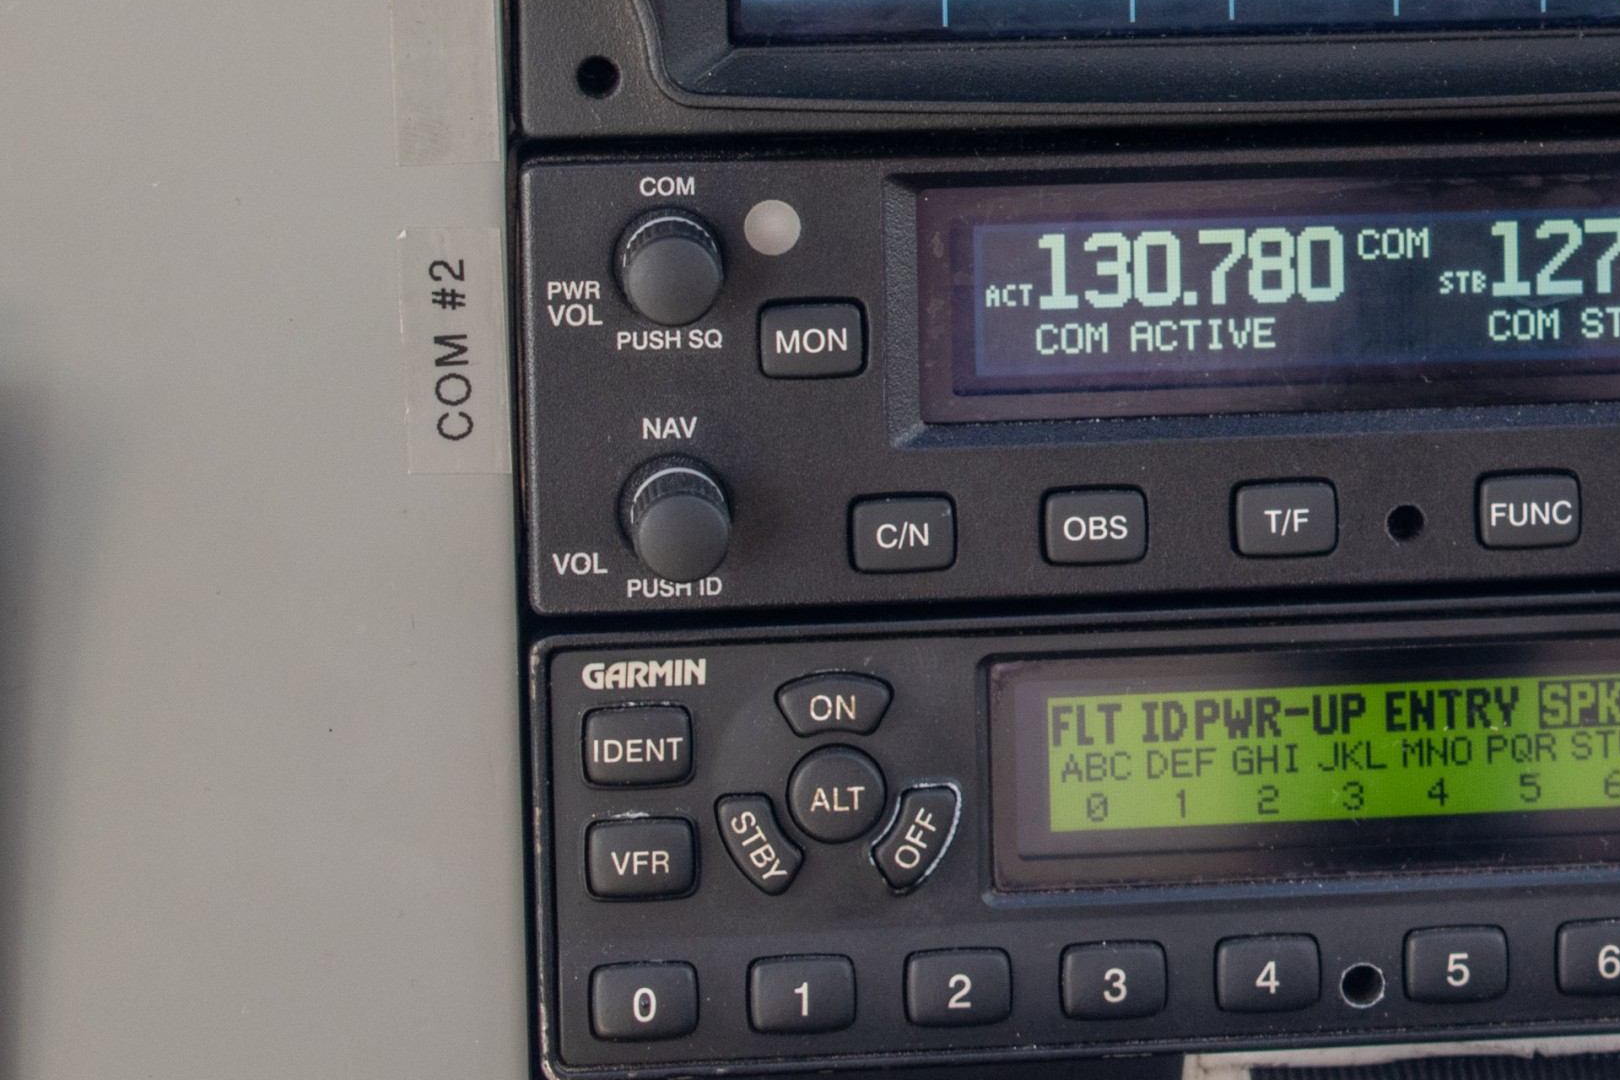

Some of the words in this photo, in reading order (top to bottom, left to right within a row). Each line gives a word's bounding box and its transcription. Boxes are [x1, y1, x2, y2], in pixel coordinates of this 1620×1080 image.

[639, 178, 695, 197] COM
[986, 284, 1034, 308] ACT
[1037, 227, 1344, 310] 130.780
[1357, 227, 1429, 260] COM
[1440, 271, 1487, 294] STB
[429, 258, 466, 310] #2
[547, 281, 601, 301] PWR
[548, 304, 602, 328] VOL
[616, 331, 678, 352] PUSH
[681, 329, 723, 350] SQ
[775, 330, 848, 354] MON
[1036, 324, 1109, 355] COM
[1130, 318, 1277, 352] ACTIVE
[1488, 308, 1561, 342] COM
[434, 334, 474, 441] COM
[642, 418, 698, 439] NAV
[1264, 509, 1309, 534] T/F
[1490, 502, 1572, 527] FUNC
[876, 523, 930, 549] C/N
[1062, 516, 1128, 542] OBS
[552, 554, 608, 576] VOL
[582, 659, 706, 689] GARMIN
[809, 695, 857, 721] ON
[1052, 704, 1121, 747] FLT
[1385, 686, 1518, 733] ENTRY
[592, 738, 683, 763] IDENT
[1062, 752, 1131, 783] ABC
[1146, 748, 1216, 779] DEF
[1232, 744, 1299, 775] GHI
[1318, 741, 1387, 772] JKL
[1402, 737, 1472, 768] MNO
[811, 786, 864, 811] ALT
[730, 811, 788, 884] STBY
[894, 807, 934, 869] OFF
[612, 851, 670, 876] VFR
[1447, 953, 1470, 986] 5
[948, 974, 972, 1009] 2
[1103, 968, 1127, 1003] 3
